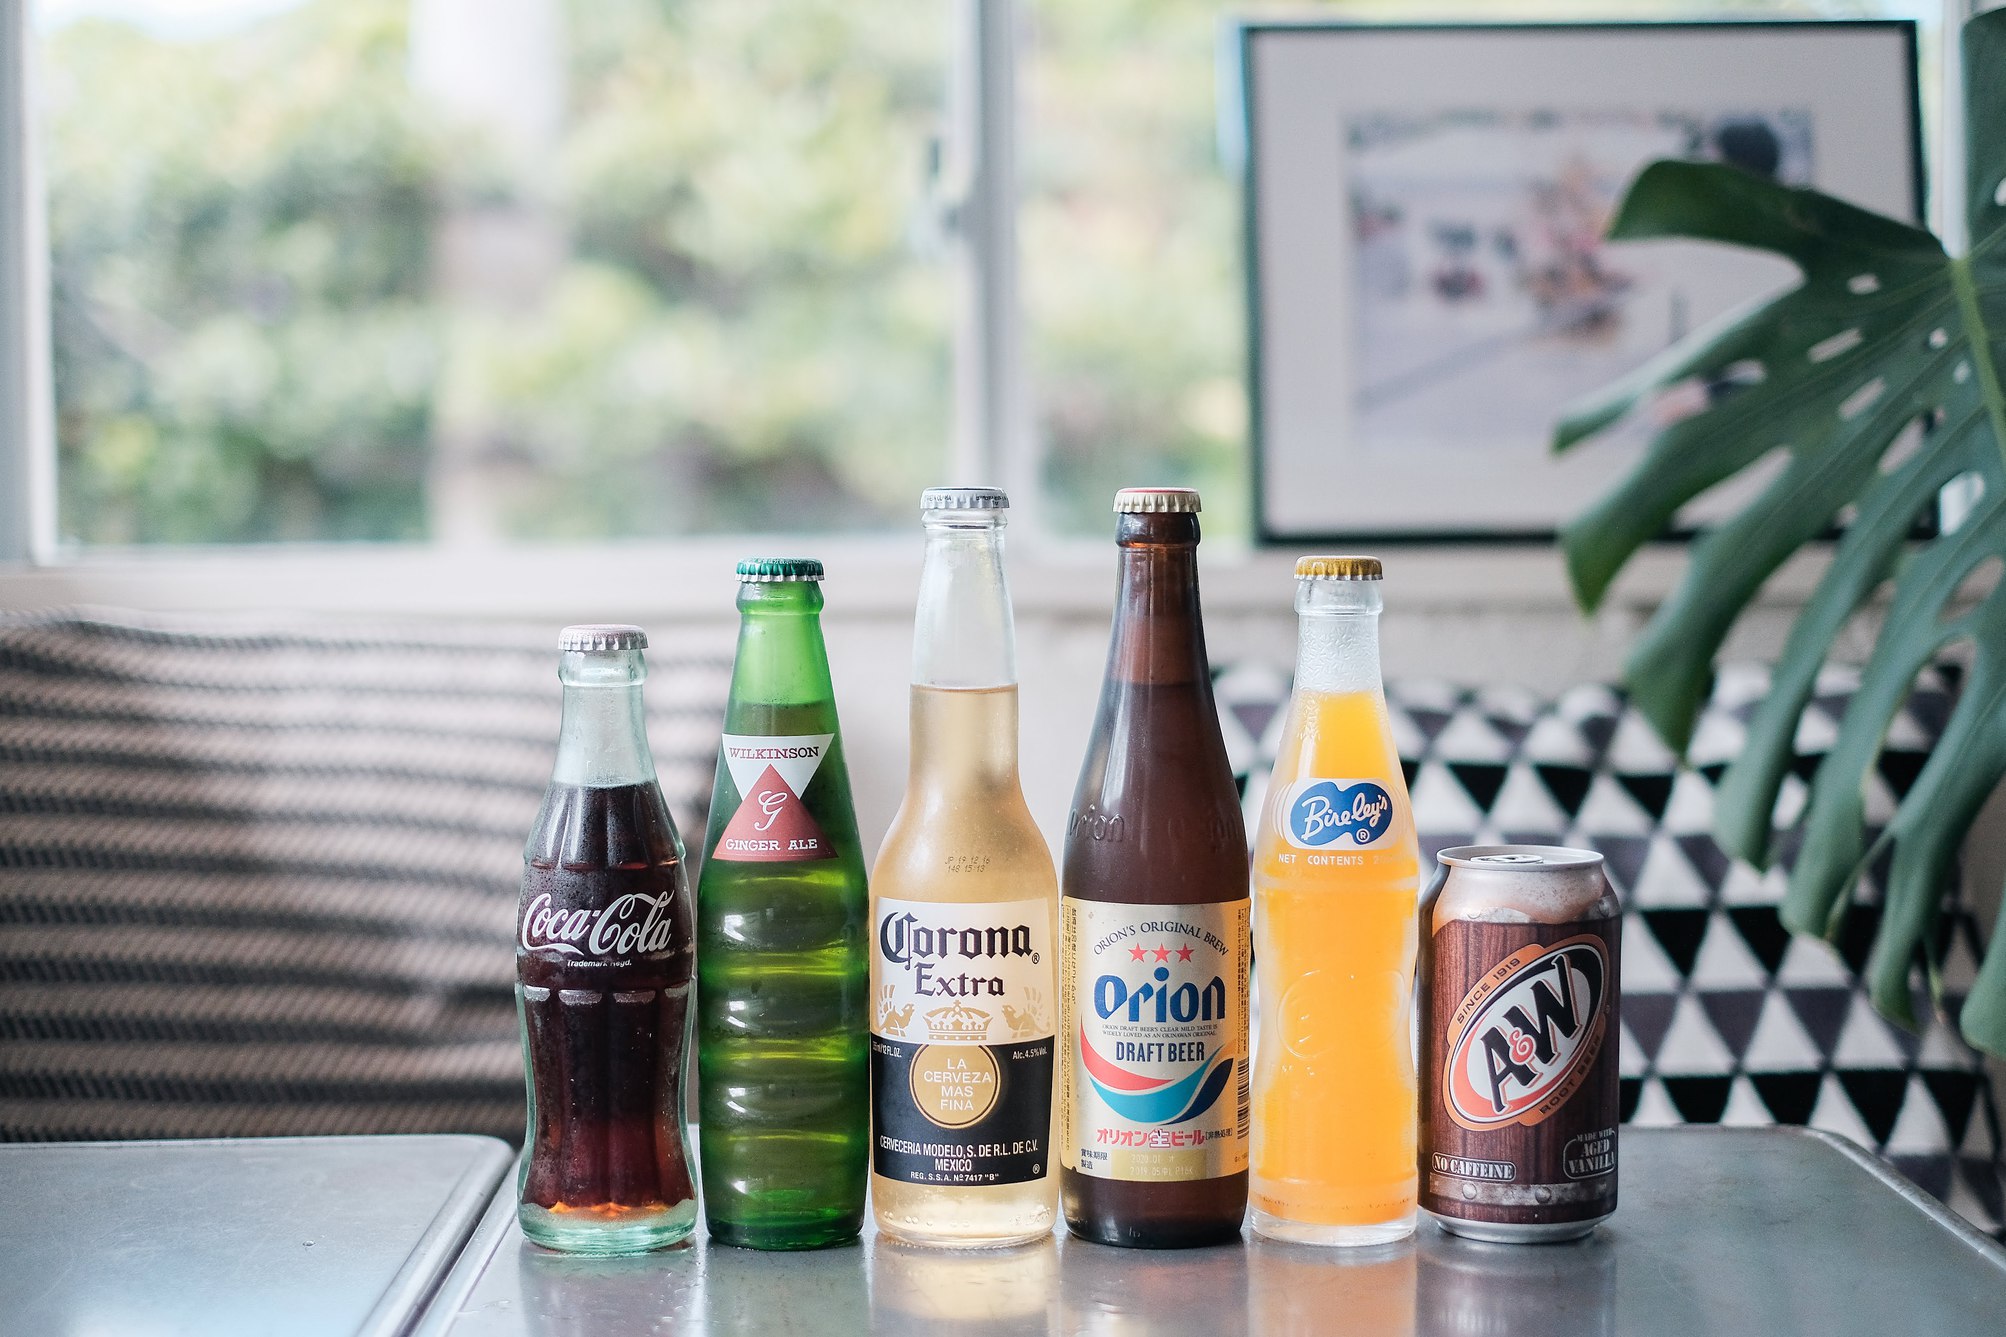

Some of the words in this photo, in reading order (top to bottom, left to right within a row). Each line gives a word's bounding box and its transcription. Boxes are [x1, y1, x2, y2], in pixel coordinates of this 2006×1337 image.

[729, 746, 819, 759] WILKINSON
[754, 790, 787, 831] G
[1301, 792, 1388, 841] Bireley's
[725, 838, 780, 851] GINGER
[787, 838, 818, 850] ALE
[1278, 853, 1297, 864] NET
[1307, 855, 1364, 866] CONTENTS
[522, 890, 675, 956] Coca-Cola
[880, 911, 1034, 971] Corona
[1093, 924, 1137, 956] ORION'S
[1140, 920, 1201, 939] ORIGINAL
[1203, 931, 1229, 956] BREW
[914, 961, 1005, 997] Extra
[1093, 966, 1226, 1023] Orion
[1456, 982, 1491, 1025] SINCE
[1493, 958, 1521, 981] 1919
[1480, 953, 1583, 1114] A&W
[1116, 1041, 1164, 1062] DRAFT
[1167, 1041, 1205, 1062] BEER
[947, 1058, 967, 1070] LA
[923, 1070, 992, 1084] CERVEZA
[941, 1085, 974, 1097] MAS
[1539, 1081, 1574, 1114] ROOT
[940, 1099, 974, 1111] FINA
[880, 1135, 921, 1155] CERVECERIA
[979, 1144, 992, 1157] DE
[993, 1142, 1011, 1157] R.L.
[1012, 1140, 1024, 1154] DE
[1025, 1138, 1038, 1153] C.V.
[910, 1171, 927, 1181] REG.
[964, 1174, 983, 1182] 7417
[934, 1158, 972, 1172] MEXICO
[1434, 1155, 1448, 1172] NO
[1449, 1160, 1513, 1180] CAFFEINE
